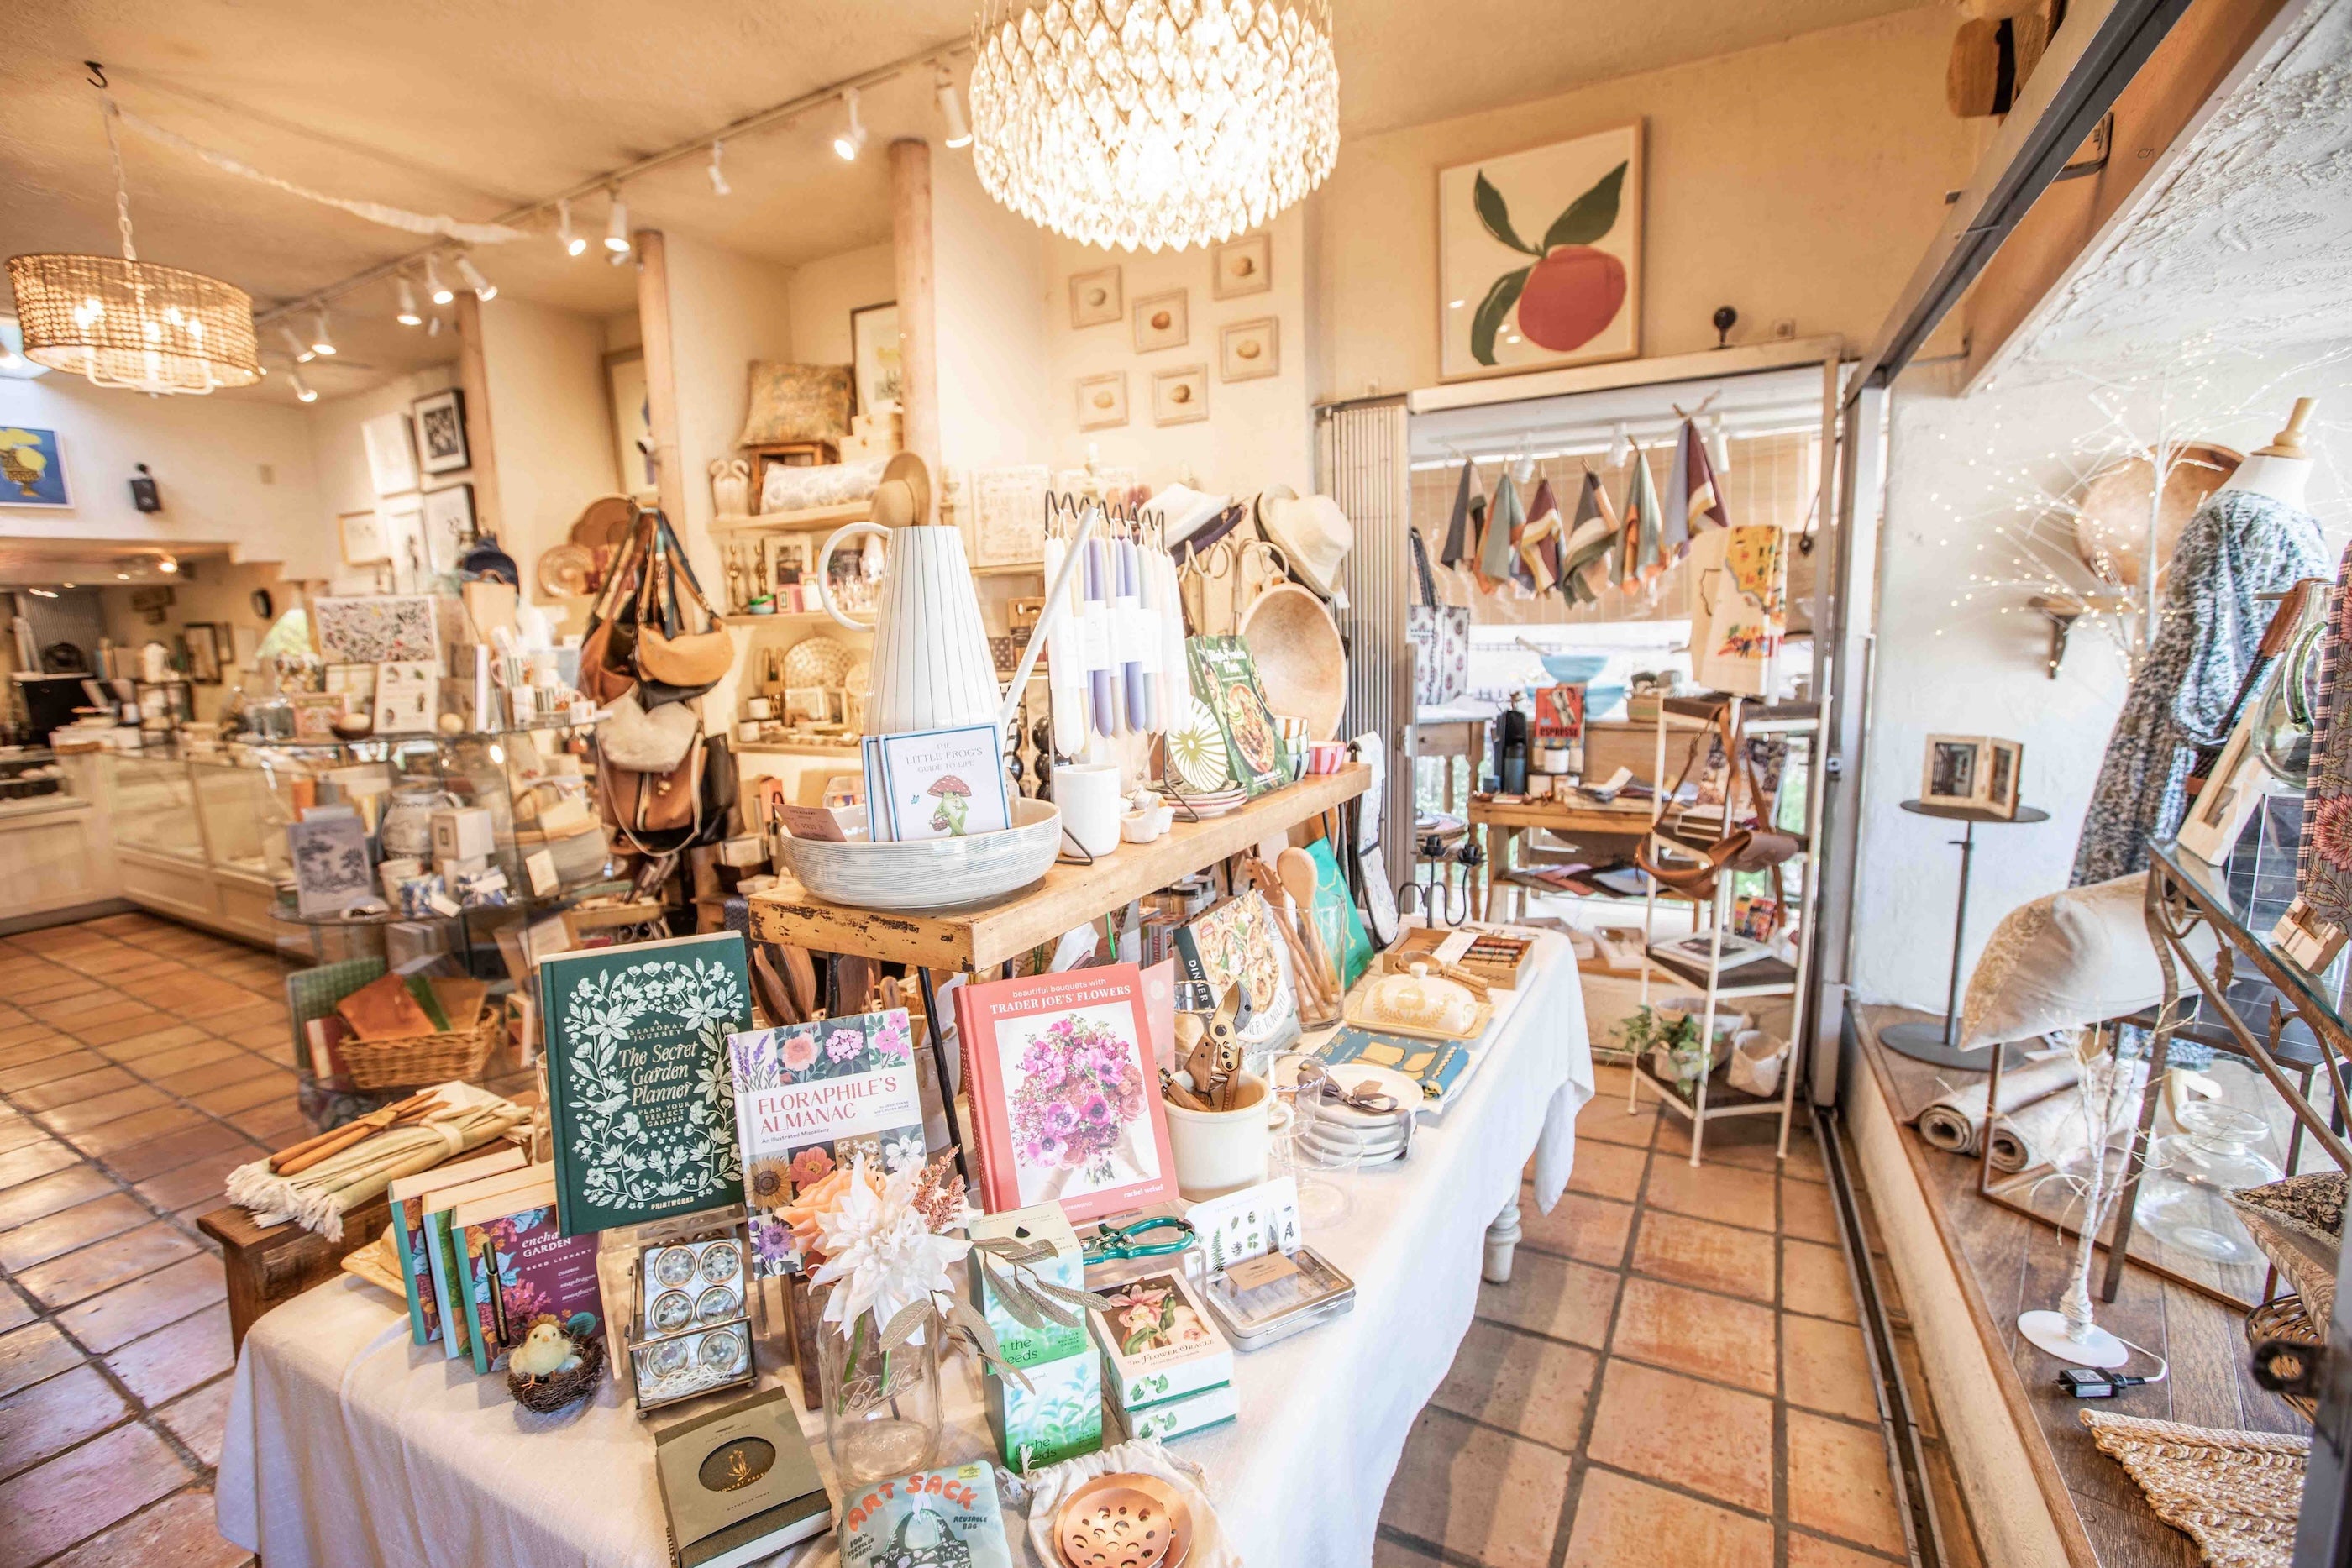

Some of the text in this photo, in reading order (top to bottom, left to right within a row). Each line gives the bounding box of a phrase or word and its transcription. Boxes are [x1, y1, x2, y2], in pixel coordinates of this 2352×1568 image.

[906, 747, 984, 765] LITTLE FROG'S
[917, 759, 974, 774] GUIDE TO LIFE
[1012, 978, 1106, 999] beautiful bouquets with
[1188, 959, 1209, 1002] DINNER
[990, 984, 1131, 1015] TRADER JOE'S FLOWERS
[629, 1022, 684, 1036] SEASONAL
[633, 1029, 681, 1042] JOURNEY
[618, 1041, 698, 1068] The Secret
[630, 1061, 689, 1086] Garden
[631, 1081, 693, 1107] Planner
[758, 1076, 897, 1115] FLORAPHILE'S
[638, 1101, 690, 1115] PLAN YOUR
[645, 1109, 685, 1121] PERFECT
[647, 1115, 684, 1127] GARDEN
[760, 1102, 857, 1135] ALMANAC
[770, 1132, 800, 1143] Illustrated
[801, 1128, 830, 1139] Miscellany
[650, 1195, 695, 1210] PRINTWORKS
[522, 1231, 559, 1248] encha
[522, 1237, 571, 1258] GARDEN
[526, 1249, 591, 1271] SEED LIBRARY
[1011, 1339, 1032, 1351] the
[1141, 1349, 1179, 1365] FLOWER
[1179, 1340, 1215, 1352] ORACLE
[1005, 1350, 1038, 1365] eeds
[848, 1475, 978, 1532] ART SACK
[953, 1515, 989, 1523] REUSABLE
[847, 1537, 874, 1559] RECYCLED
[849, 1533, 869, 1549] 100%
[851, 1544, 873, 1562] FABRIC
